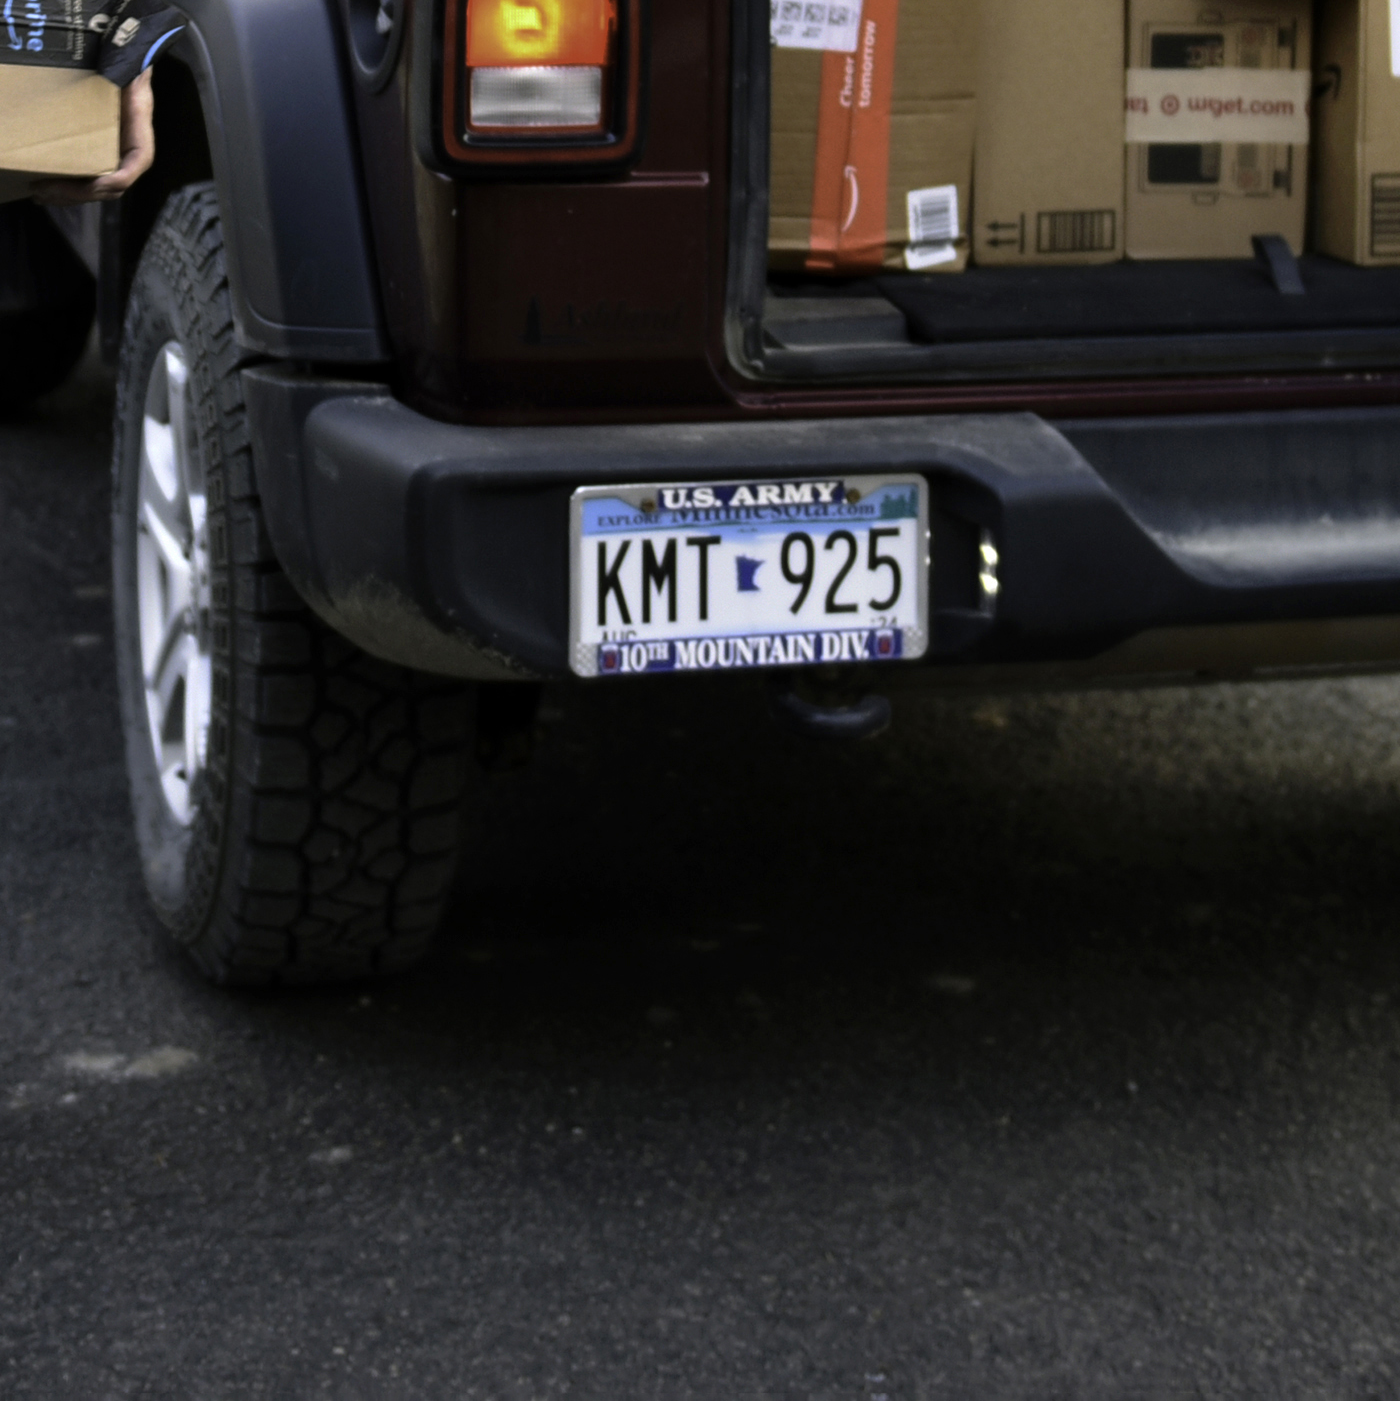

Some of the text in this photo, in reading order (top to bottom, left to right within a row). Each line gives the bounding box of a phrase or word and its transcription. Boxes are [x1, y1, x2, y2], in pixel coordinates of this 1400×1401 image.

[857, 19, 877, 109] tomorrow
[662, 481, 839, 510] U.S. ARMY
[597, 510, 662, 528] EXPLORE
[597, 527, 902, 627] KMT 925
[619, 631, 871, 673] 10TH MOUNTAIN DIV.
